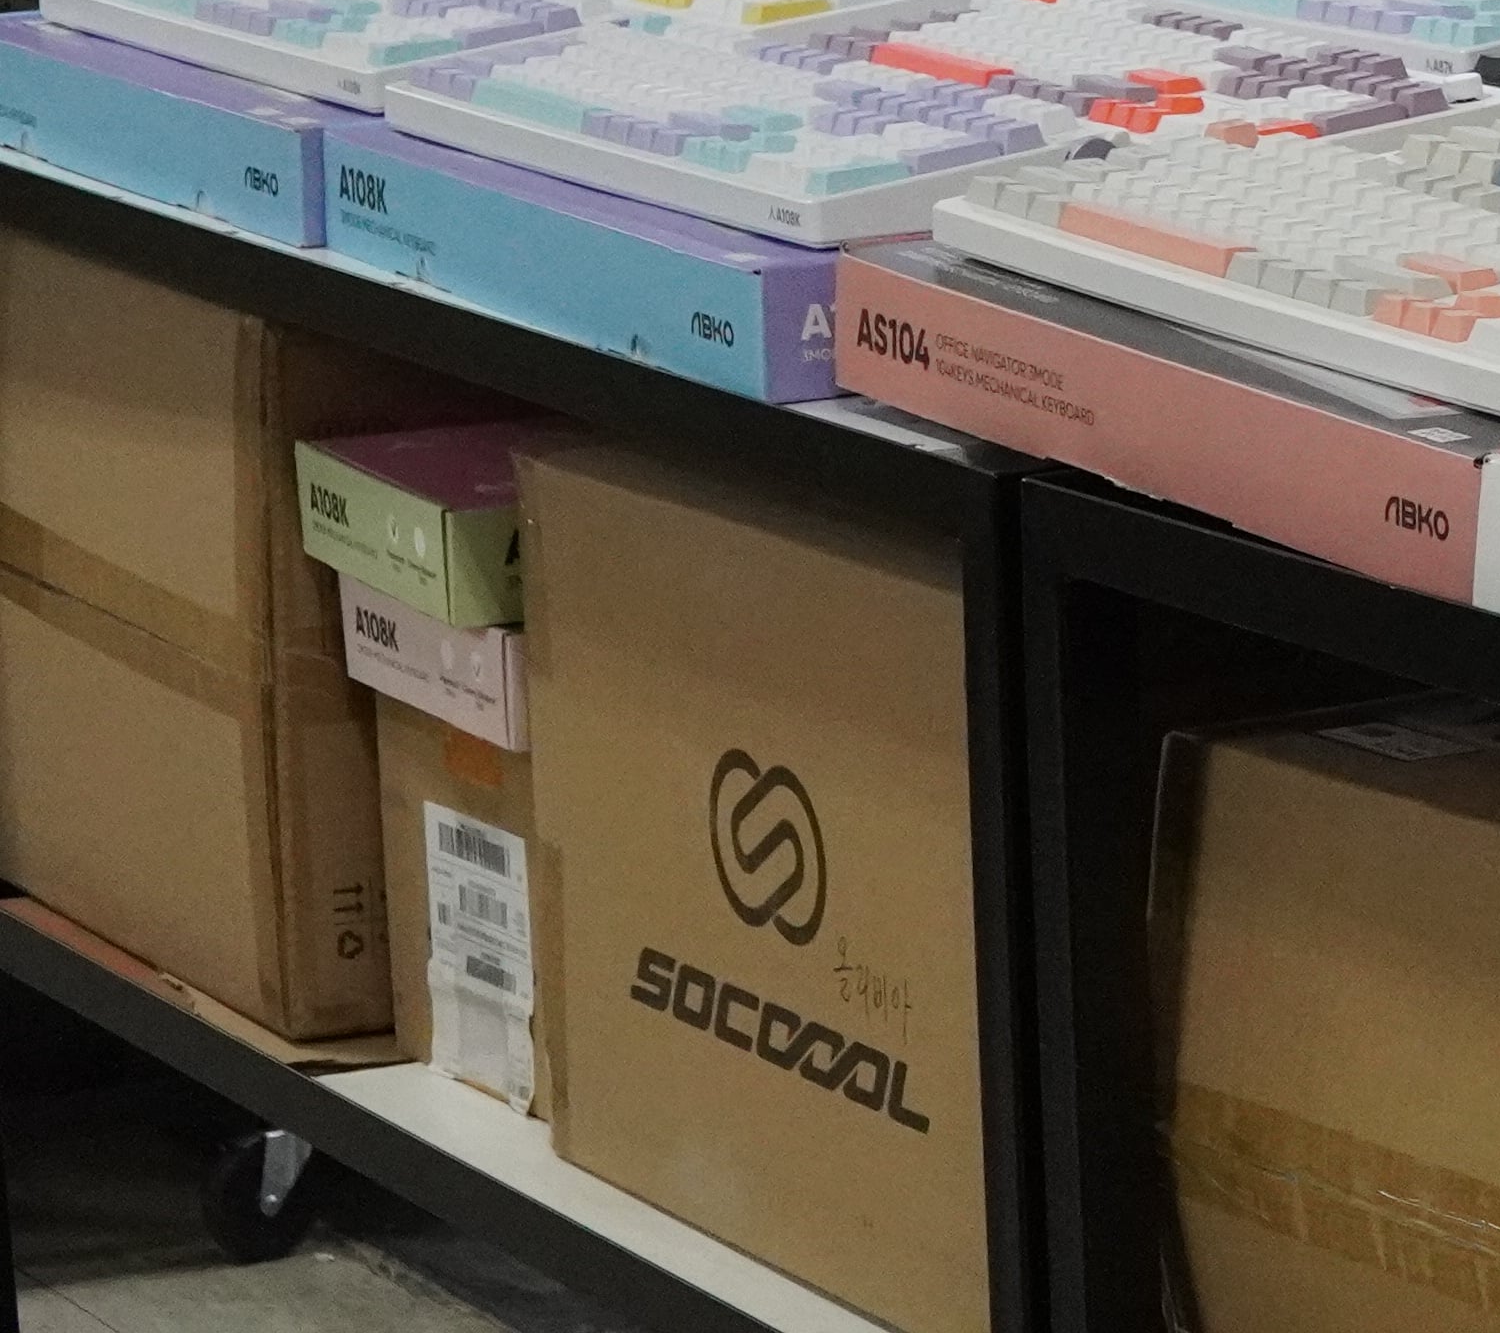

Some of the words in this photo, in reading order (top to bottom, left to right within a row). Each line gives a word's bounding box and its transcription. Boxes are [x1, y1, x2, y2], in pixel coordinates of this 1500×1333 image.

[339, 164, 388, 215] A108K
[690, 311, 735, 348] ABKO
[856, 307, 930, 371] AS104
[936, 333, 969, 359] OFFICE
[971, 345, 1027, 376] NAVIGATOR
[976, 370, 1041, 410] MECHANICAL
[1041, 395, 1095, 427] KEYBOARD
[310, 483, 350, 527] A108K
[1384, 494, 1451, 542] ABKO
[355, 606, 400, 653] A108K
